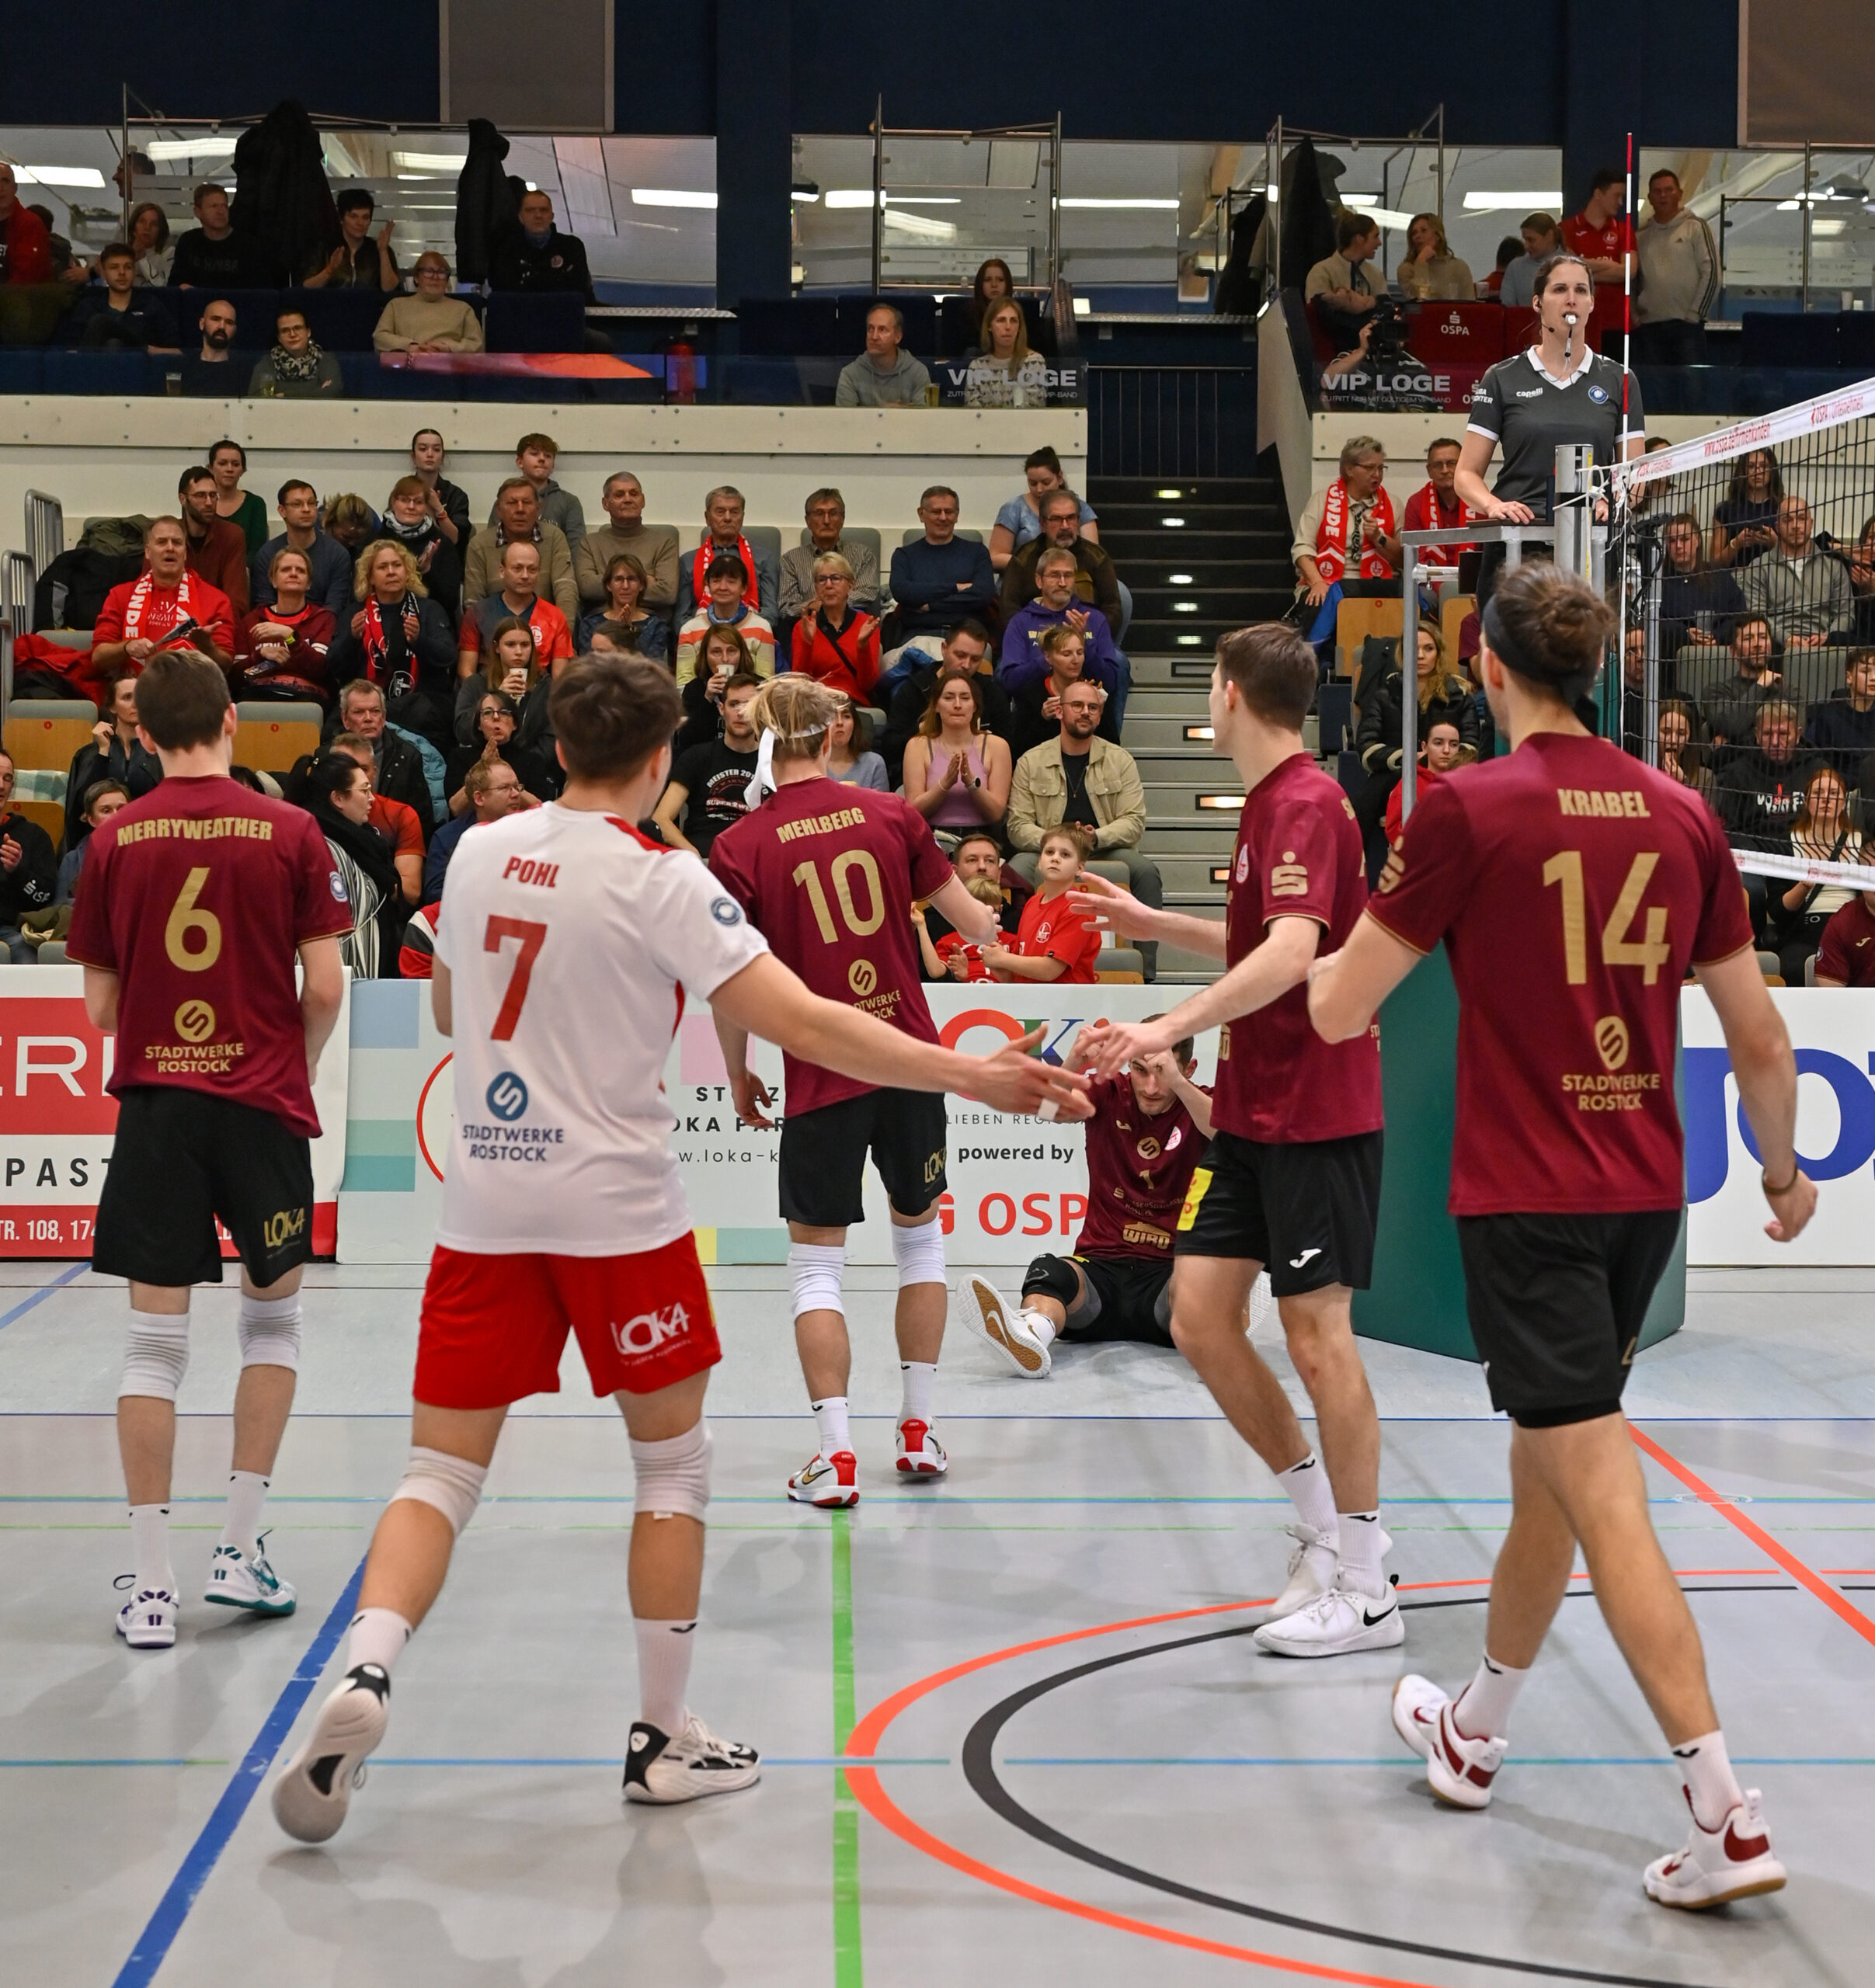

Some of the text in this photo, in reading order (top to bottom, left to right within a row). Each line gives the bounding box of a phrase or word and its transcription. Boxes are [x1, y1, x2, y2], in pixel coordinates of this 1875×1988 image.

[1441, 325, 1470, 335] OSPA
[948, 369, 1077, 387] VIP LOGE
[1323, 374, 1451, 391] VIP LOGE
[1516, 388, 1543, 398] capelli
[706, 769, 739, 788] MEISTER
[1557, 788, 1651, 817] KRABEL
[117, 817, 272, 846] MERRYWEATHER
[776, 807, 866, 843] MEHLBERG
[503, 856, 559, 888] POHL
[792, 850, 885, 944] 10
[165, 867, 221, 971] 6
[1543, 851, 1670, 985] 14
[484, 914, 547, 1041] 7
[145, 1043, 244, 1058] STADTWERKE
[158, 1059, 231, 1073] ROSTOCK
[946, 1114, 1003, 1124] LIEBEN
[462, 1125, 564, 1143] STADTWERKE
[469, 1144, 547, 1162] ROSTOCK
[958, 1145, 1074, 1164] powered by
[1139, 1170, 1155, 1190] 1
[26, 1219, 64, 1242] 108,
[264, 1208, 305, 1248] LOKA
[610, 1302, 690, 1355] LOKA
